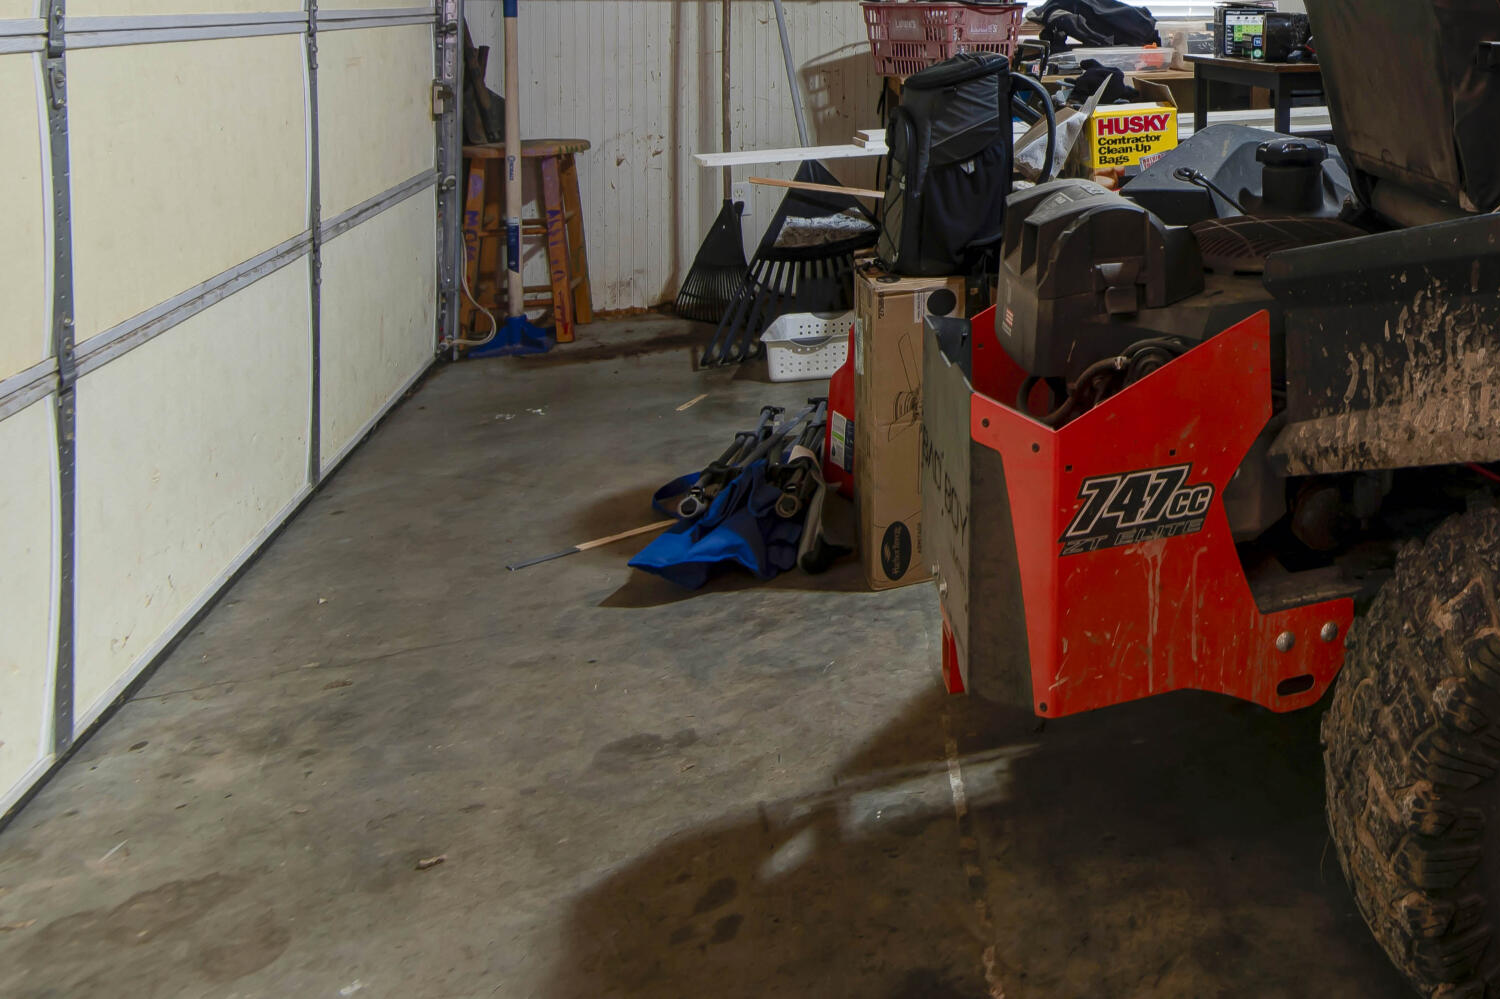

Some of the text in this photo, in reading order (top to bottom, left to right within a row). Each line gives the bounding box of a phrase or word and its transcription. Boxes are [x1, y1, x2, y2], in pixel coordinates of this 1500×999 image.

[1096, 112, 1171, 137] HUSKY
[1097, 133, 1162, 146] Contractor
[1098, 154, 1130, 166] Bags
[943, 471, 969, 547] BOY
[1062, 517, 1205, 556] ZT ELITE
